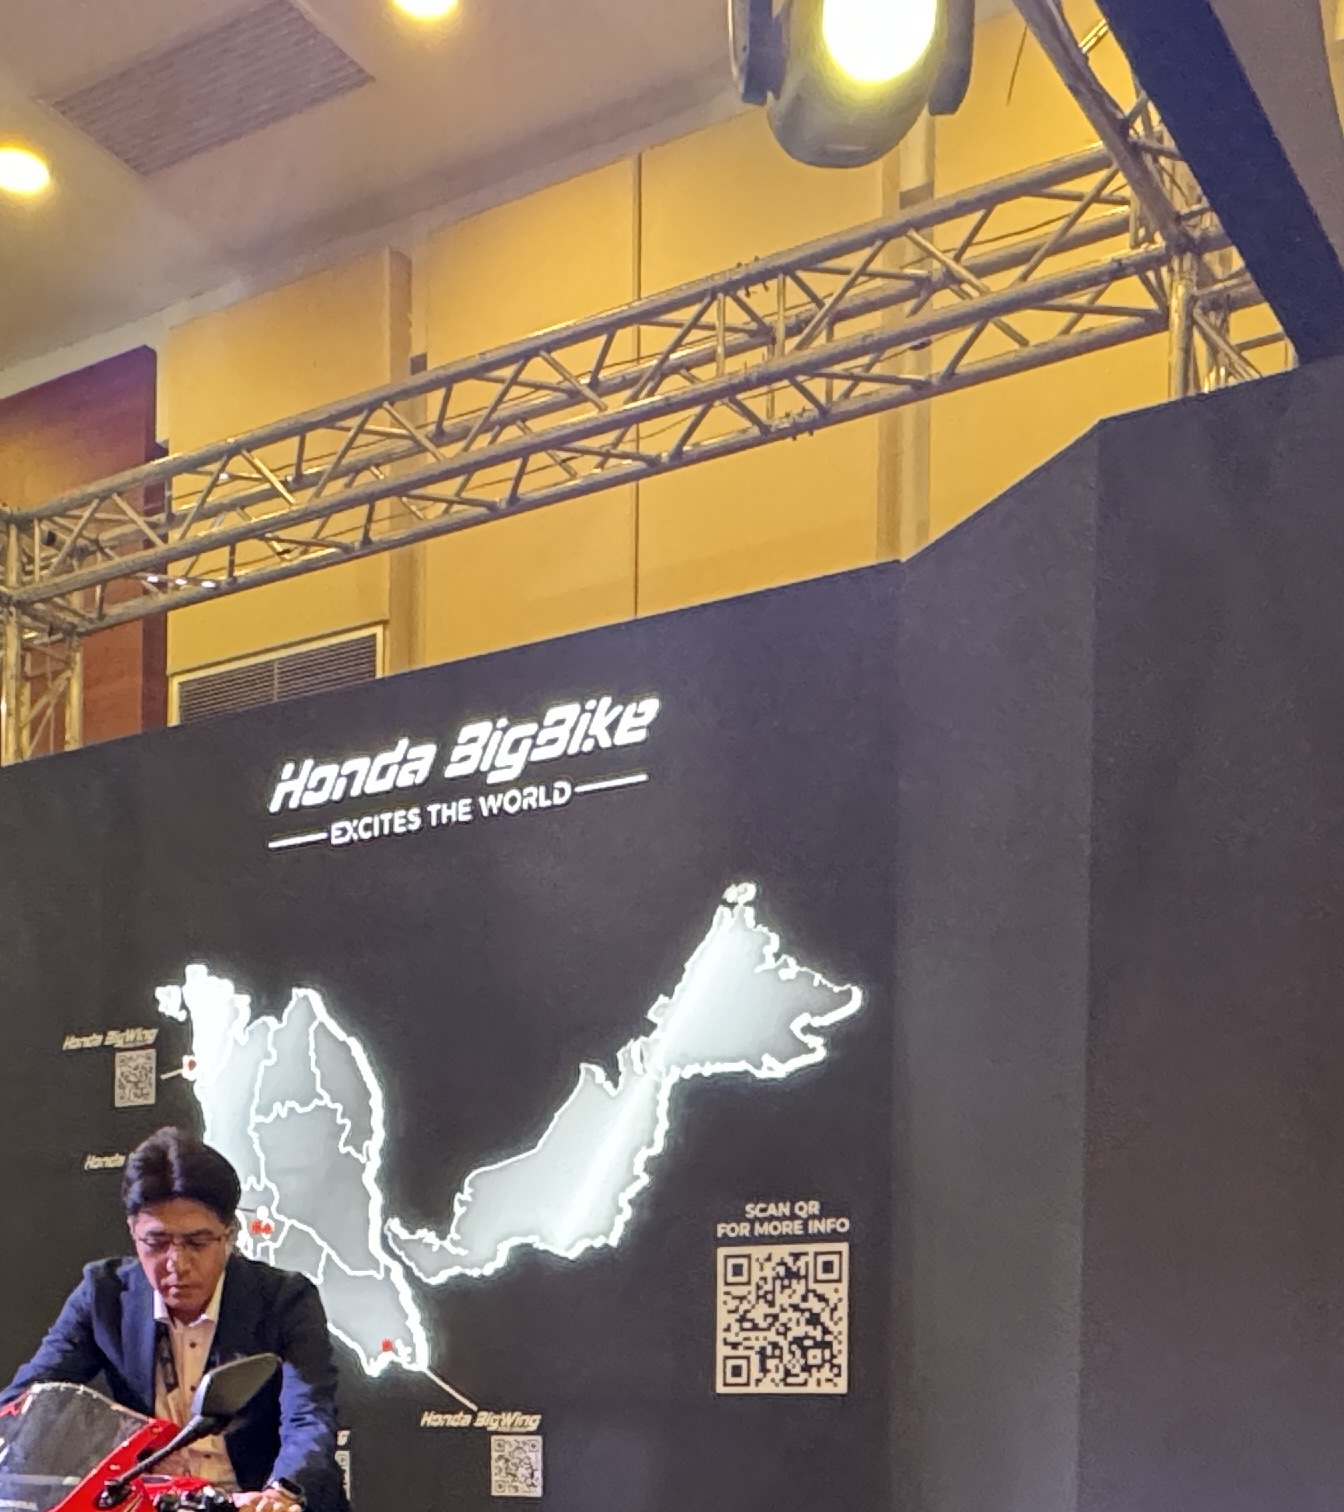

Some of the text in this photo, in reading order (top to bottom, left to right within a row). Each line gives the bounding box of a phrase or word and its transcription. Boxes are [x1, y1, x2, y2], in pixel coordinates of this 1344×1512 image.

[267, 696, 660, 813] Honda BigBike
[329, 780, 573, 846] EXCITES THE WORLD
[745, 1200, 821, 1218] SCAN QR
[717, 1218, 850, 1238] FOR MORE INFO
[420, 1411, 542, 1431] Honda BigWing
